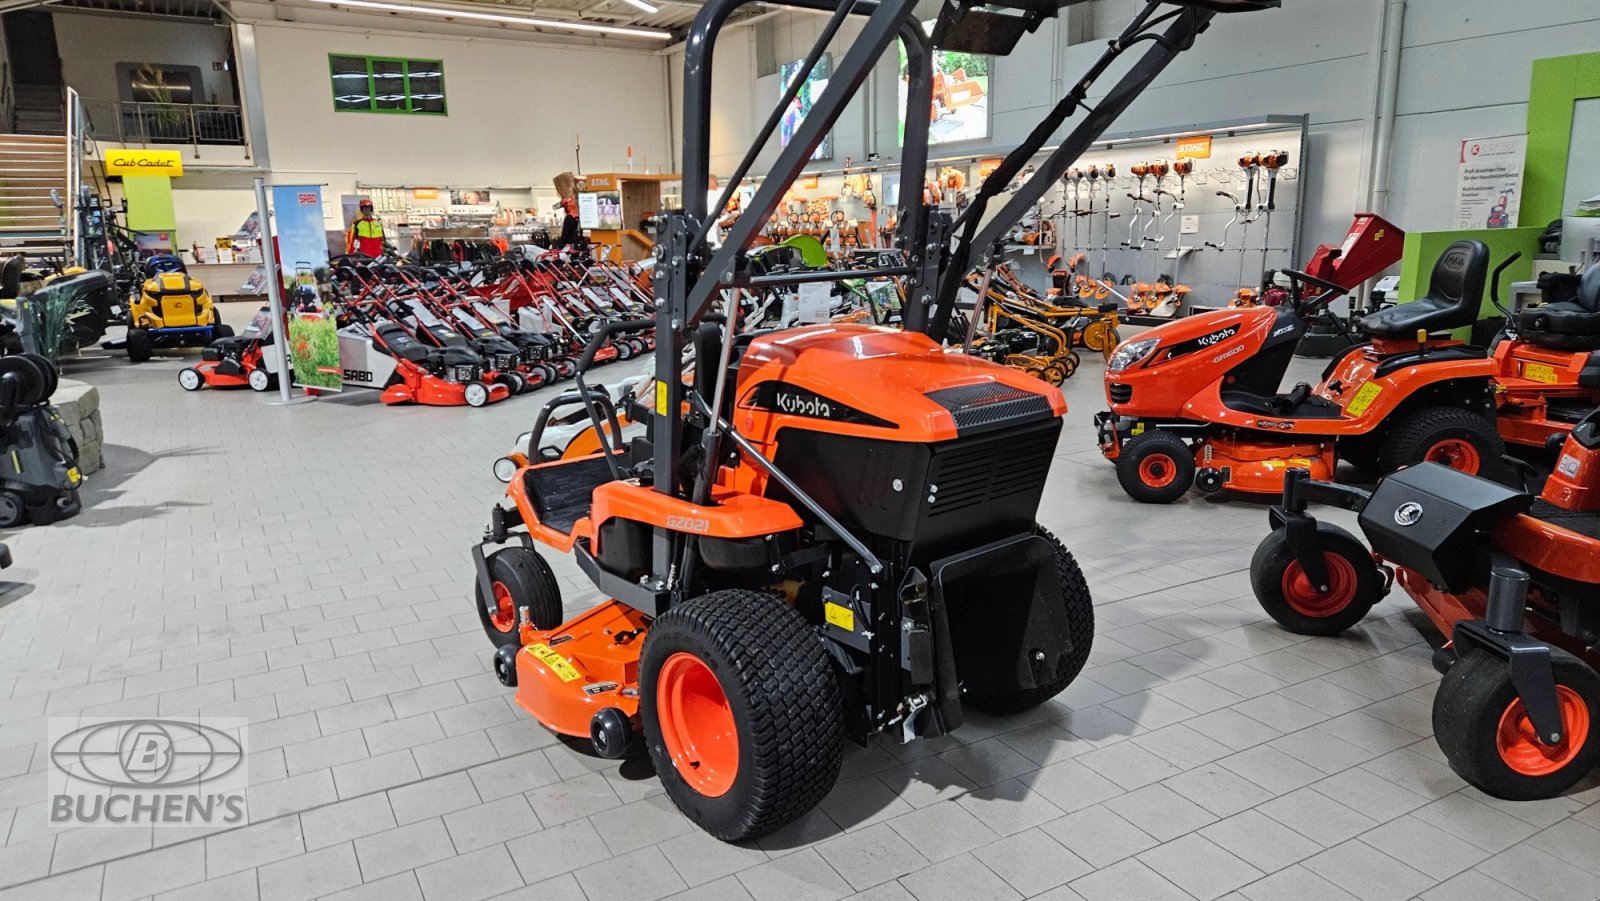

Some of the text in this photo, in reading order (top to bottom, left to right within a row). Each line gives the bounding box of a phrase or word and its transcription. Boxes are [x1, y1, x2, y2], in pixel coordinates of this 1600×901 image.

[113, 158, 175, 167] Cub Cadet
[299, 194, 316, 203] SABO
[1198, 328, 1236, 346] Kubota
[343, 369, 373, 382] SABO
[777, 393, 830, 417] Kubota
